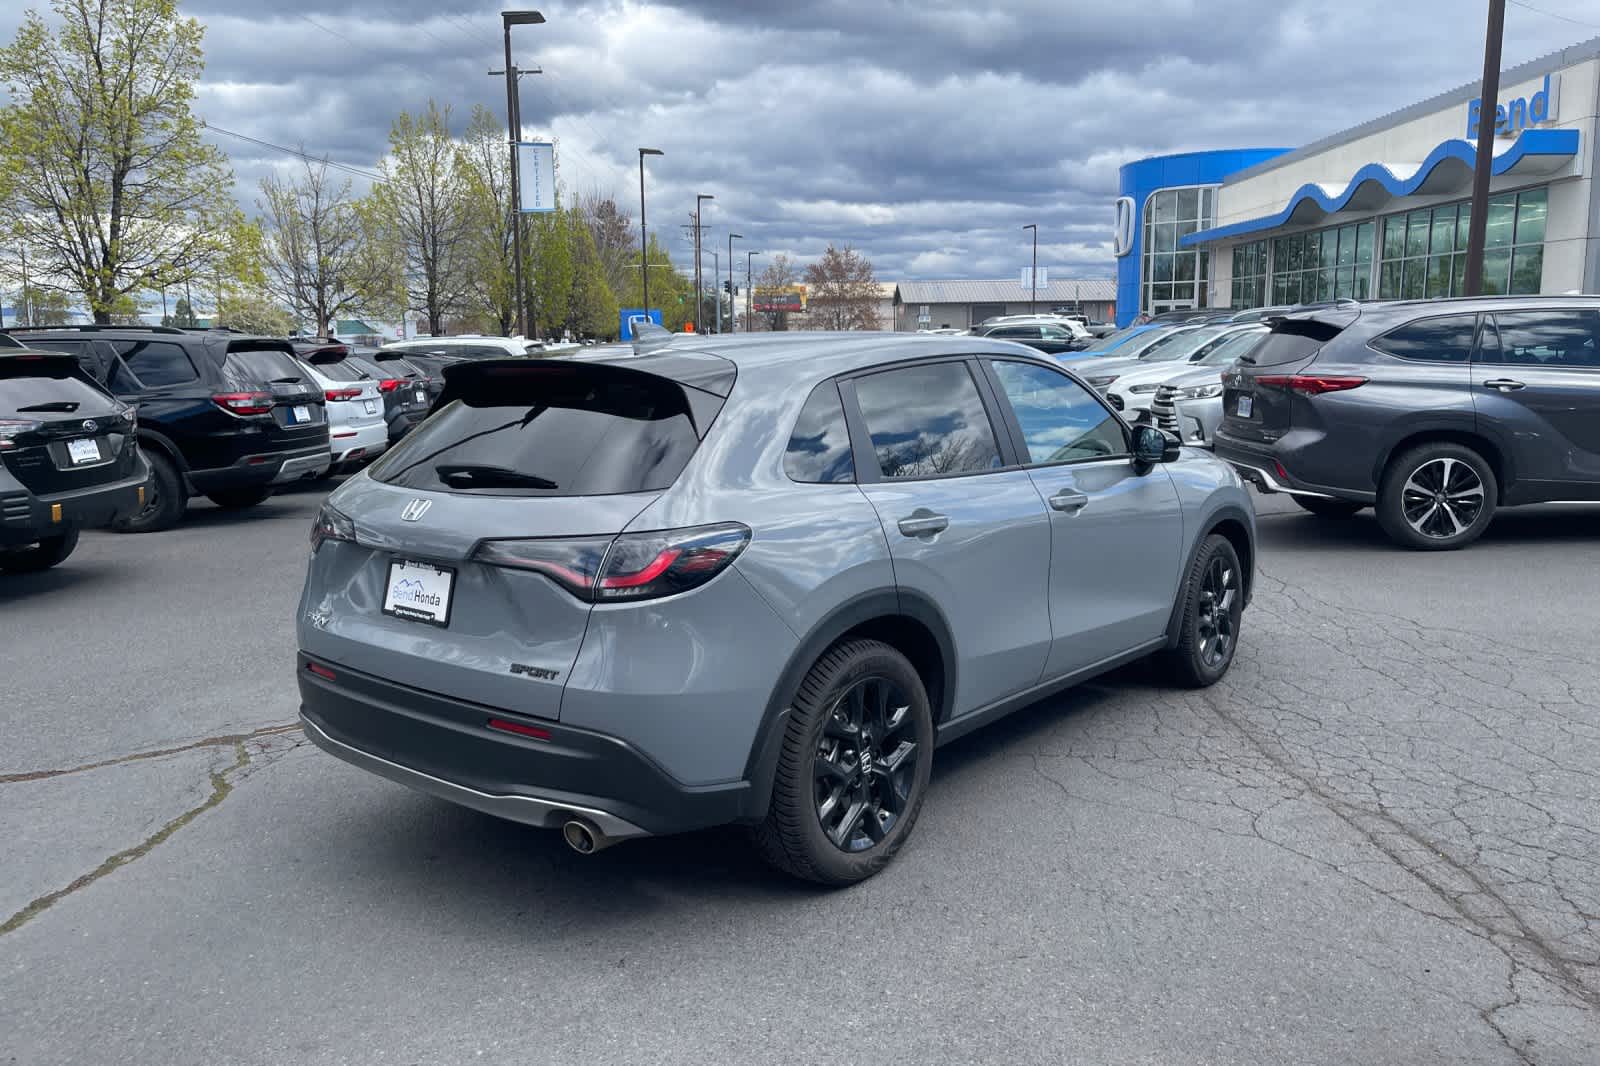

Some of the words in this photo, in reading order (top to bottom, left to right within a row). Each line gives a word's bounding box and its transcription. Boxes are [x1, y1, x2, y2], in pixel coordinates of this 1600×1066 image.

[392, 585, 415, 601] Bend
[414, 590, 441, 607] Honda
[510, 662, 559, 681] SPORT
